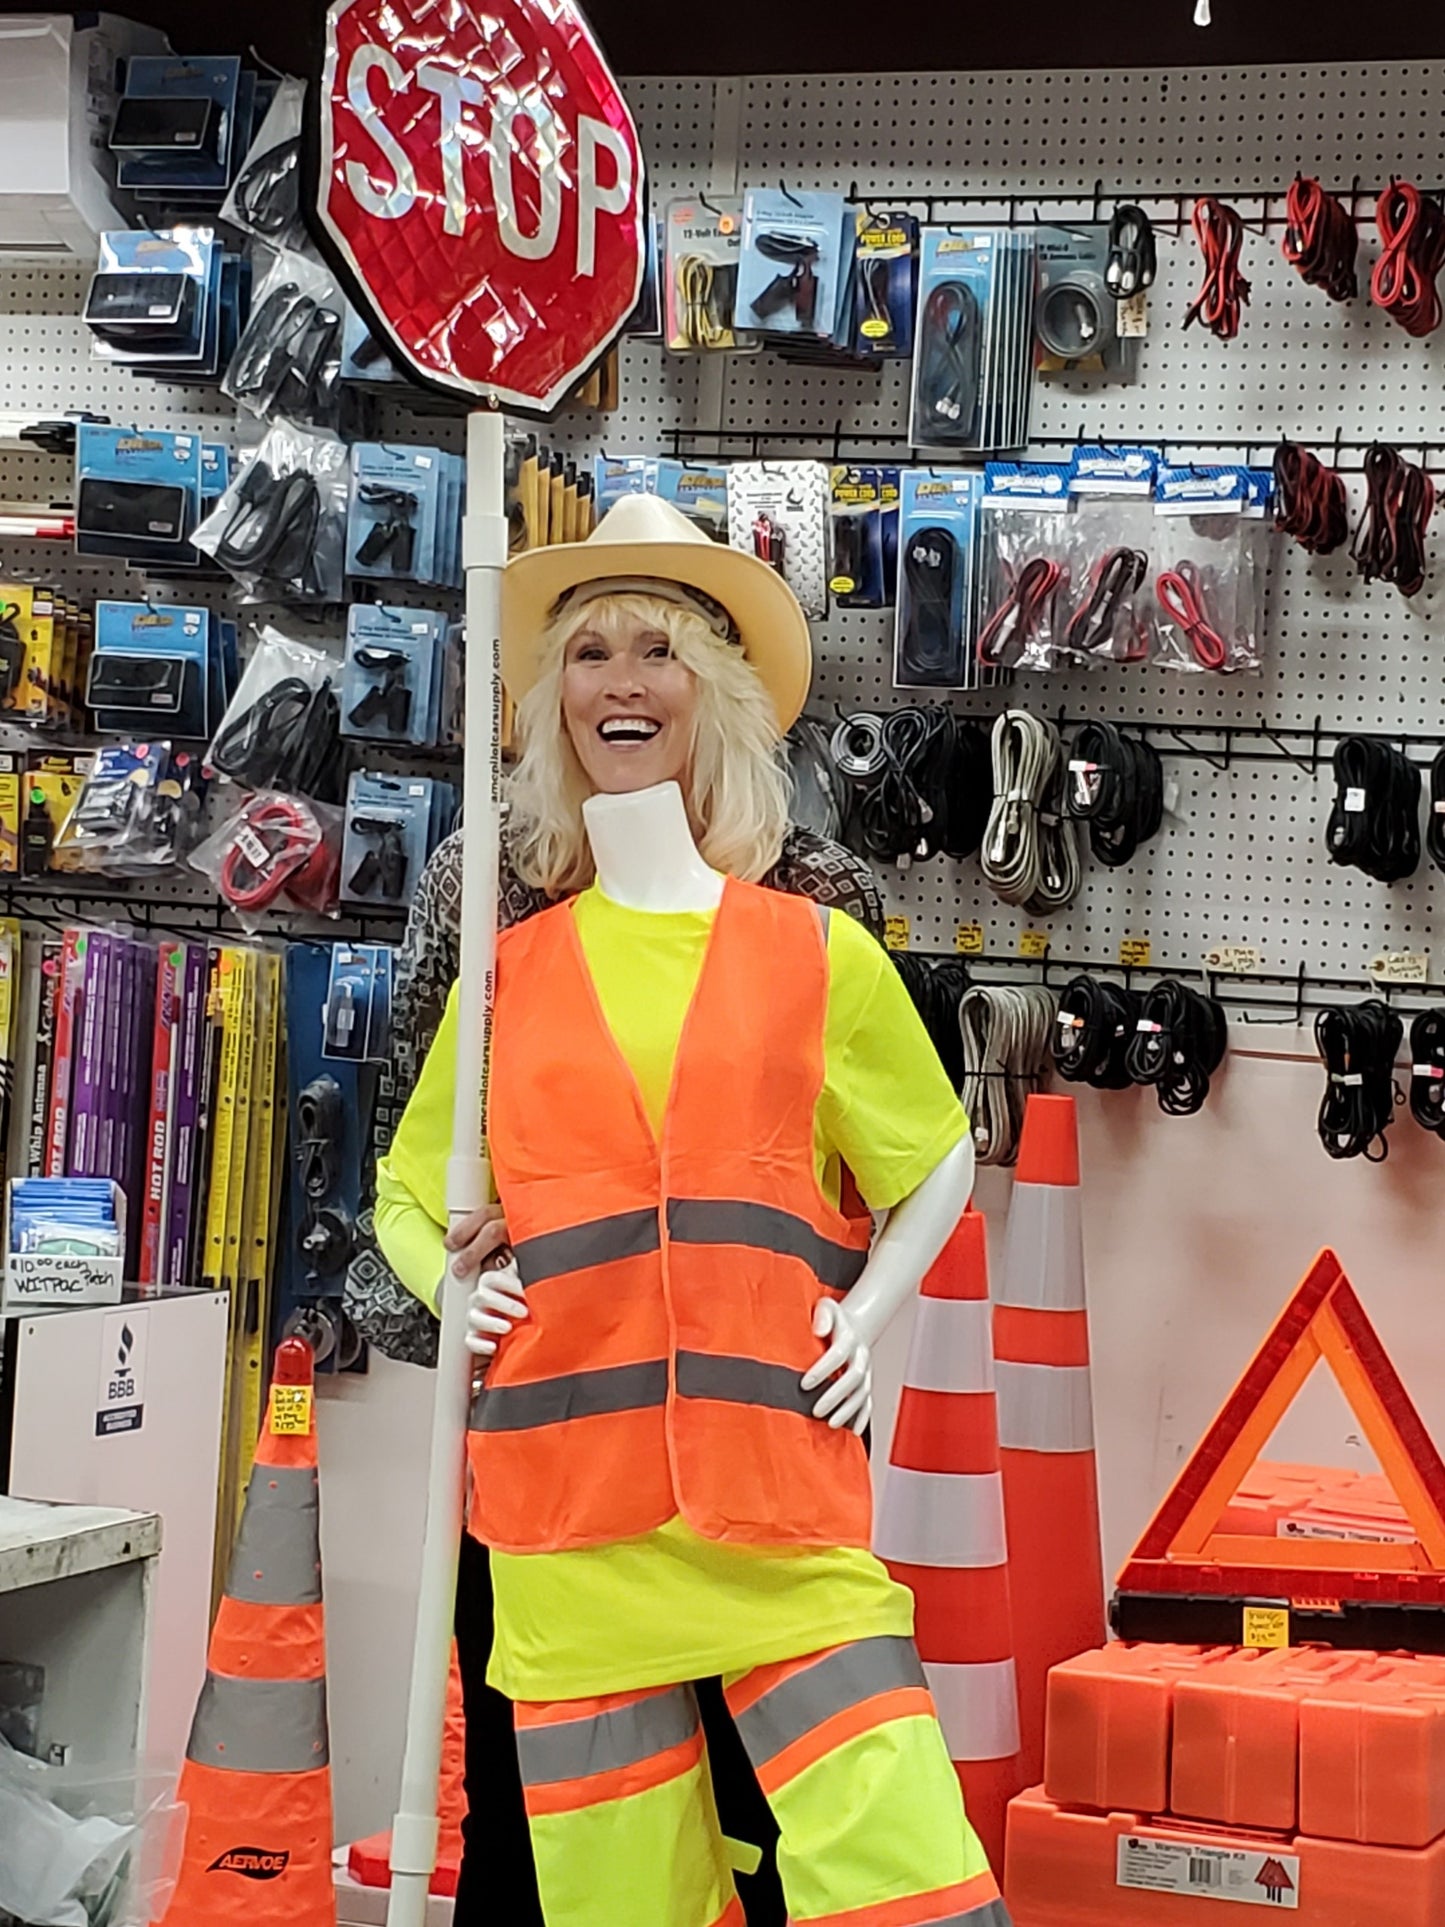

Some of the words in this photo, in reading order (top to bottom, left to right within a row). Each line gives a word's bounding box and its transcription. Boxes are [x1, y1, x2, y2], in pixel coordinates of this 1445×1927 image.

[345, 44, 632, 278] STOP
[33, 1063, 47, 1116] Antenna
[29, 1119, 42, 1163] Whip
[153, 1120, 166, 1159] ROD
[150, 1161, 163, 1200] HOT
[109, 1379, 134, 1400] BBB
[219, 1854, 285, 1870] AERVOE
